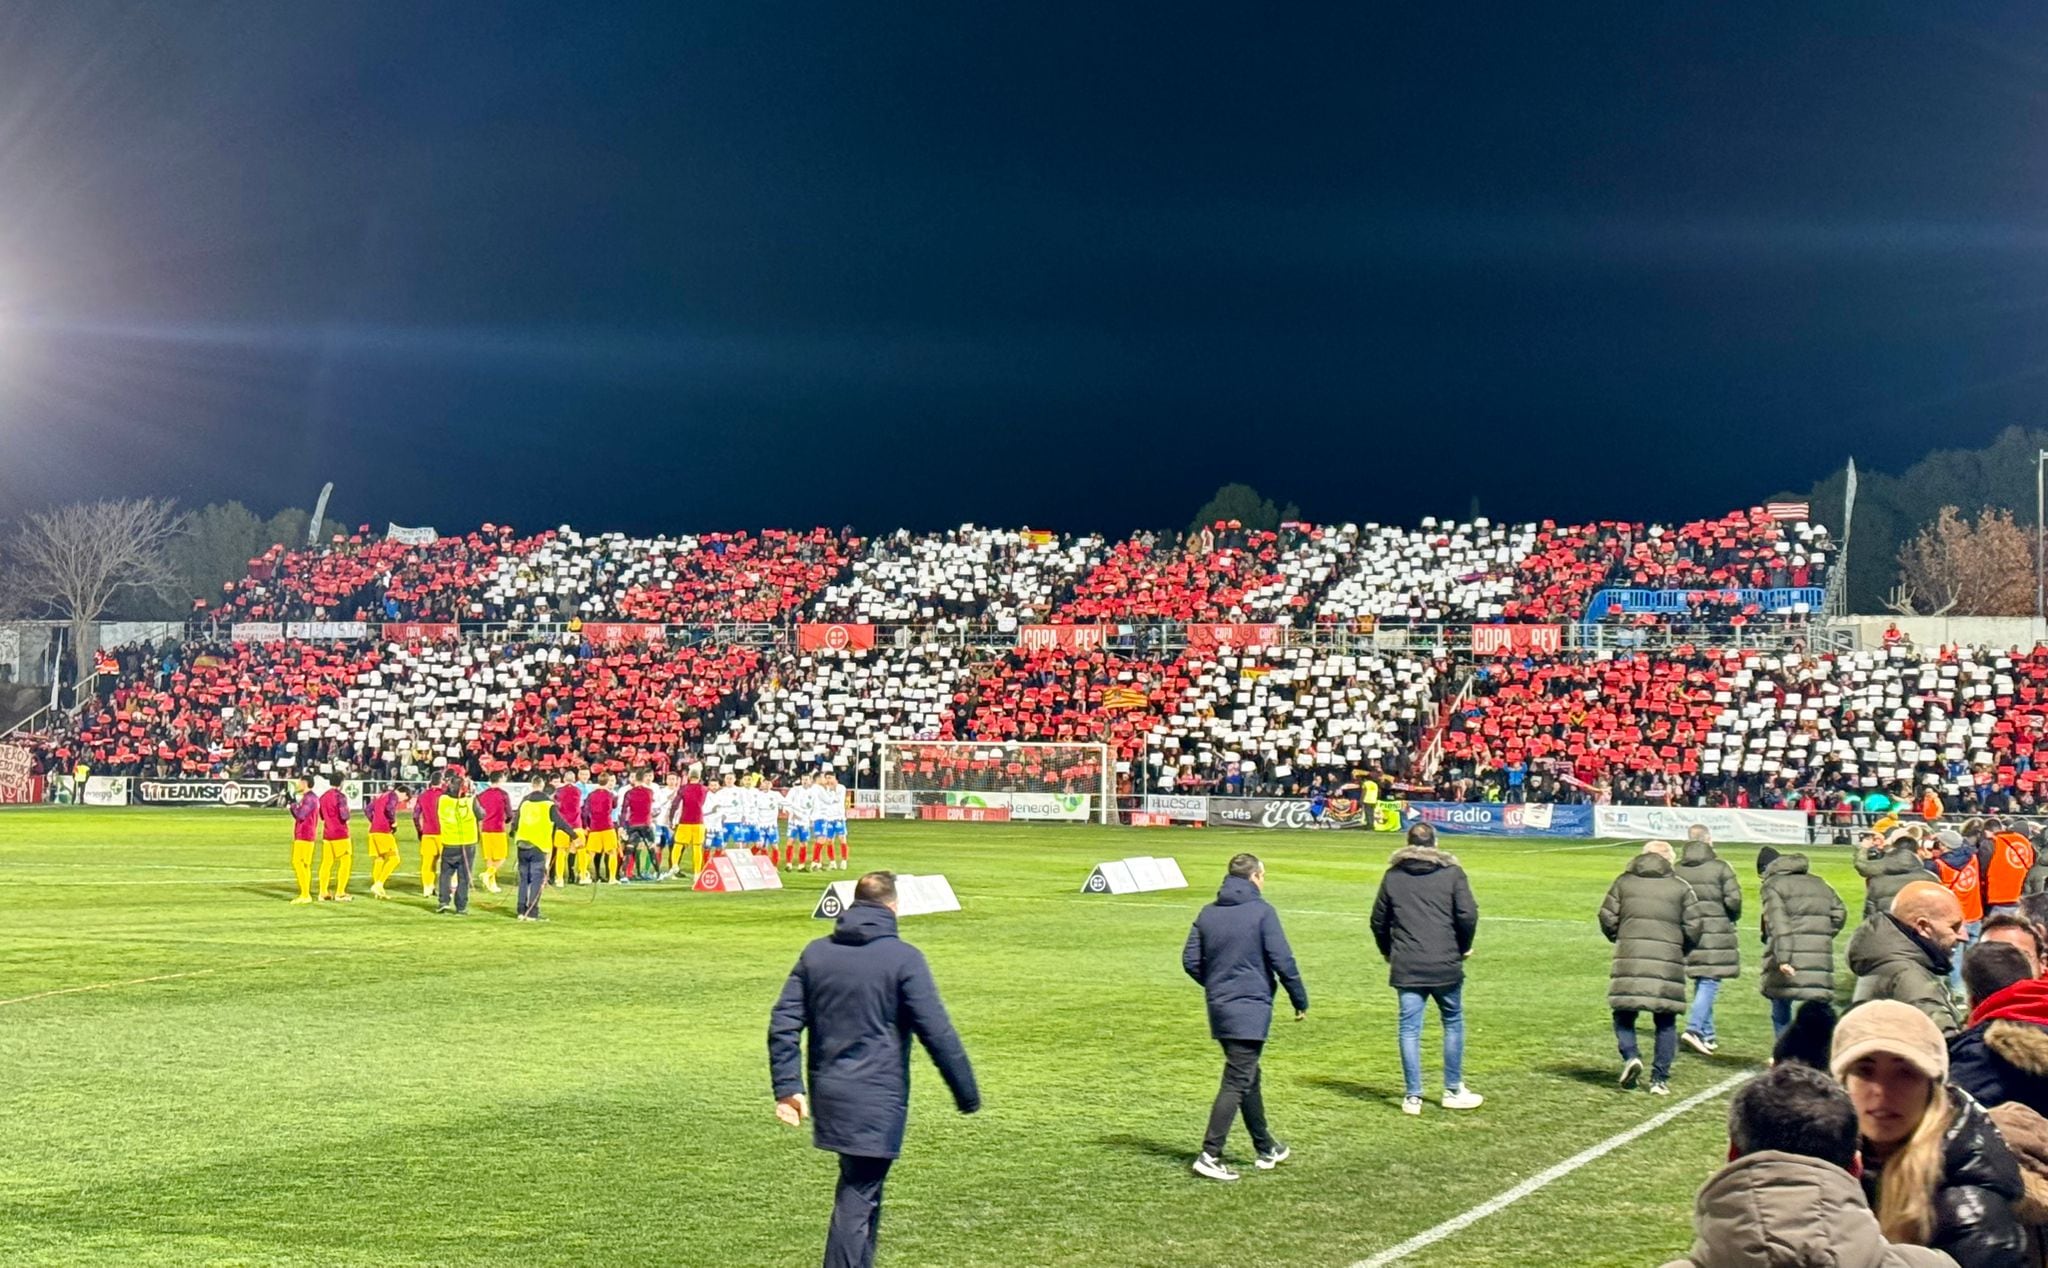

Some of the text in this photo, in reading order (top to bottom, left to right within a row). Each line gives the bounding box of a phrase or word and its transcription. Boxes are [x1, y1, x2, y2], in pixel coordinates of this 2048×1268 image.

[1024, 629, 1099, 651] COPA REY
[1474, 628, 1559, 653] COPA REY
[1221, 808, 1252, 820] cafés
